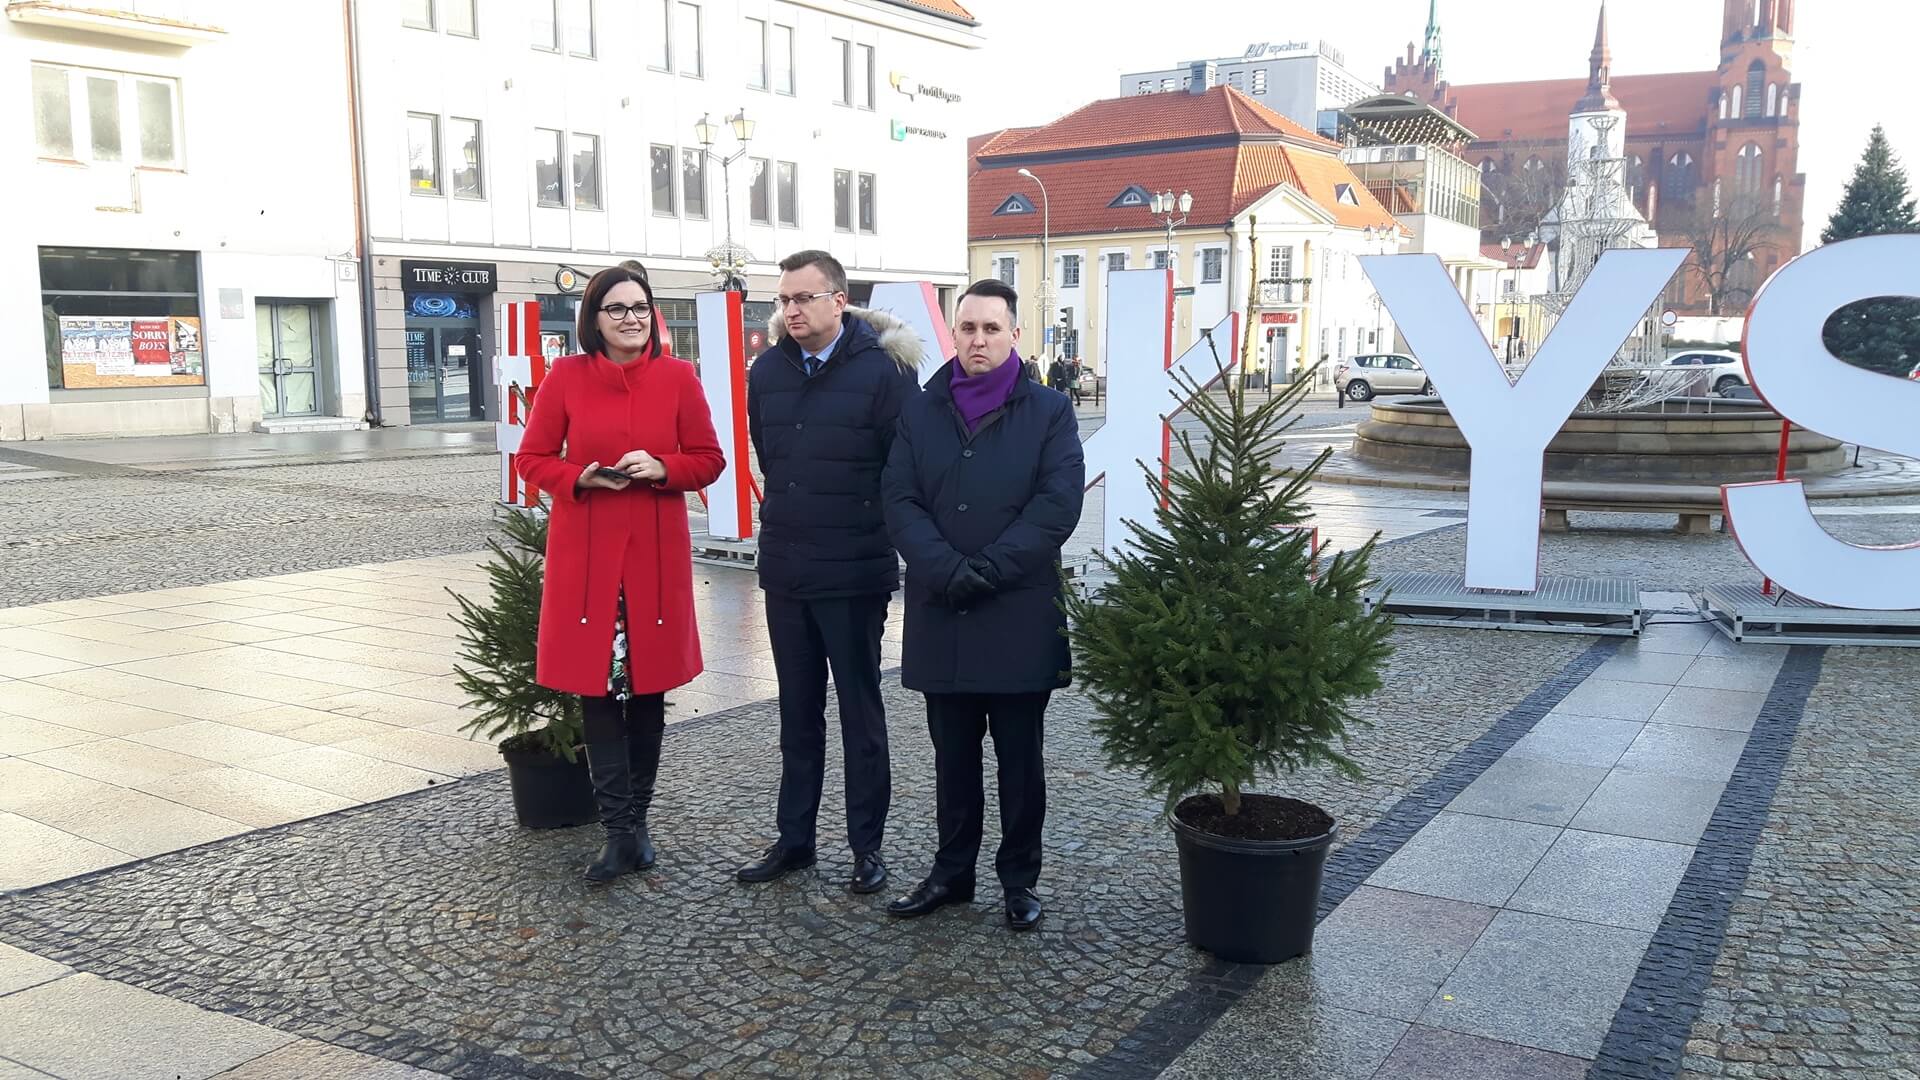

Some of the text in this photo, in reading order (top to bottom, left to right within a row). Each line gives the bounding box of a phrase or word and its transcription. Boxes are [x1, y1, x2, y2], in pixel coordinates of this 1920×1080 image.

[413, 268, 489, 284] TIME CLUB
[132, 331, 168, 340] SORRY
[404, 331, 425, 342] TIME
[139, 341, 166, 351] BOYS
